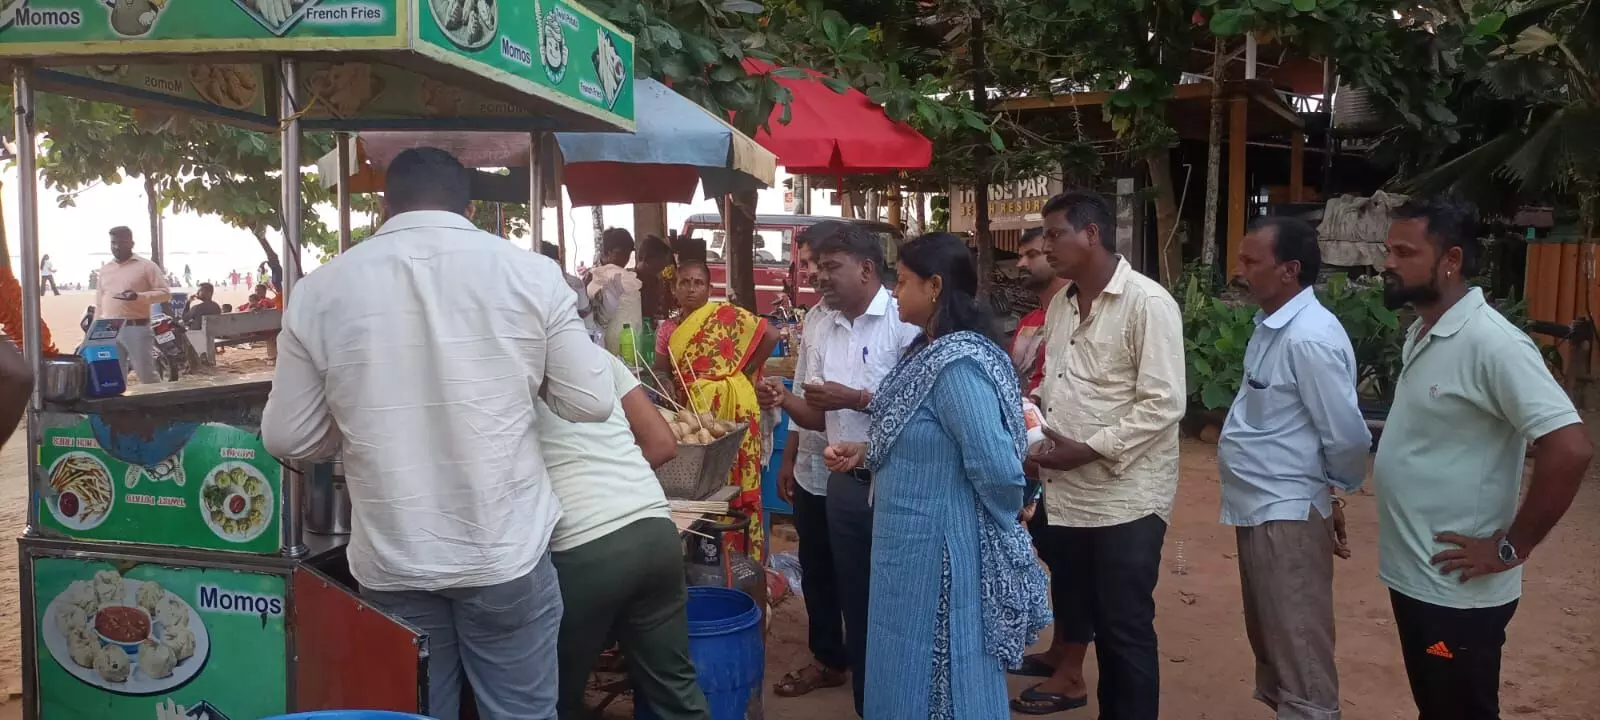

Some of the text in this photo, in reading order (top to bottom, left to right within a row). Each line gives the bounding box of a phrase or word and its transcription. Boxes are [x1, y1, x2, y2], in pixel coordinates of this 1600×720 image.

[16, 8, 80, 26] Momos
[306, 7, 381, 19] French Fries
[502, 38, 531, 64] Momos
[200, 586, 281, 614] Momos
[1425, 648, 1453, 658] adidas
